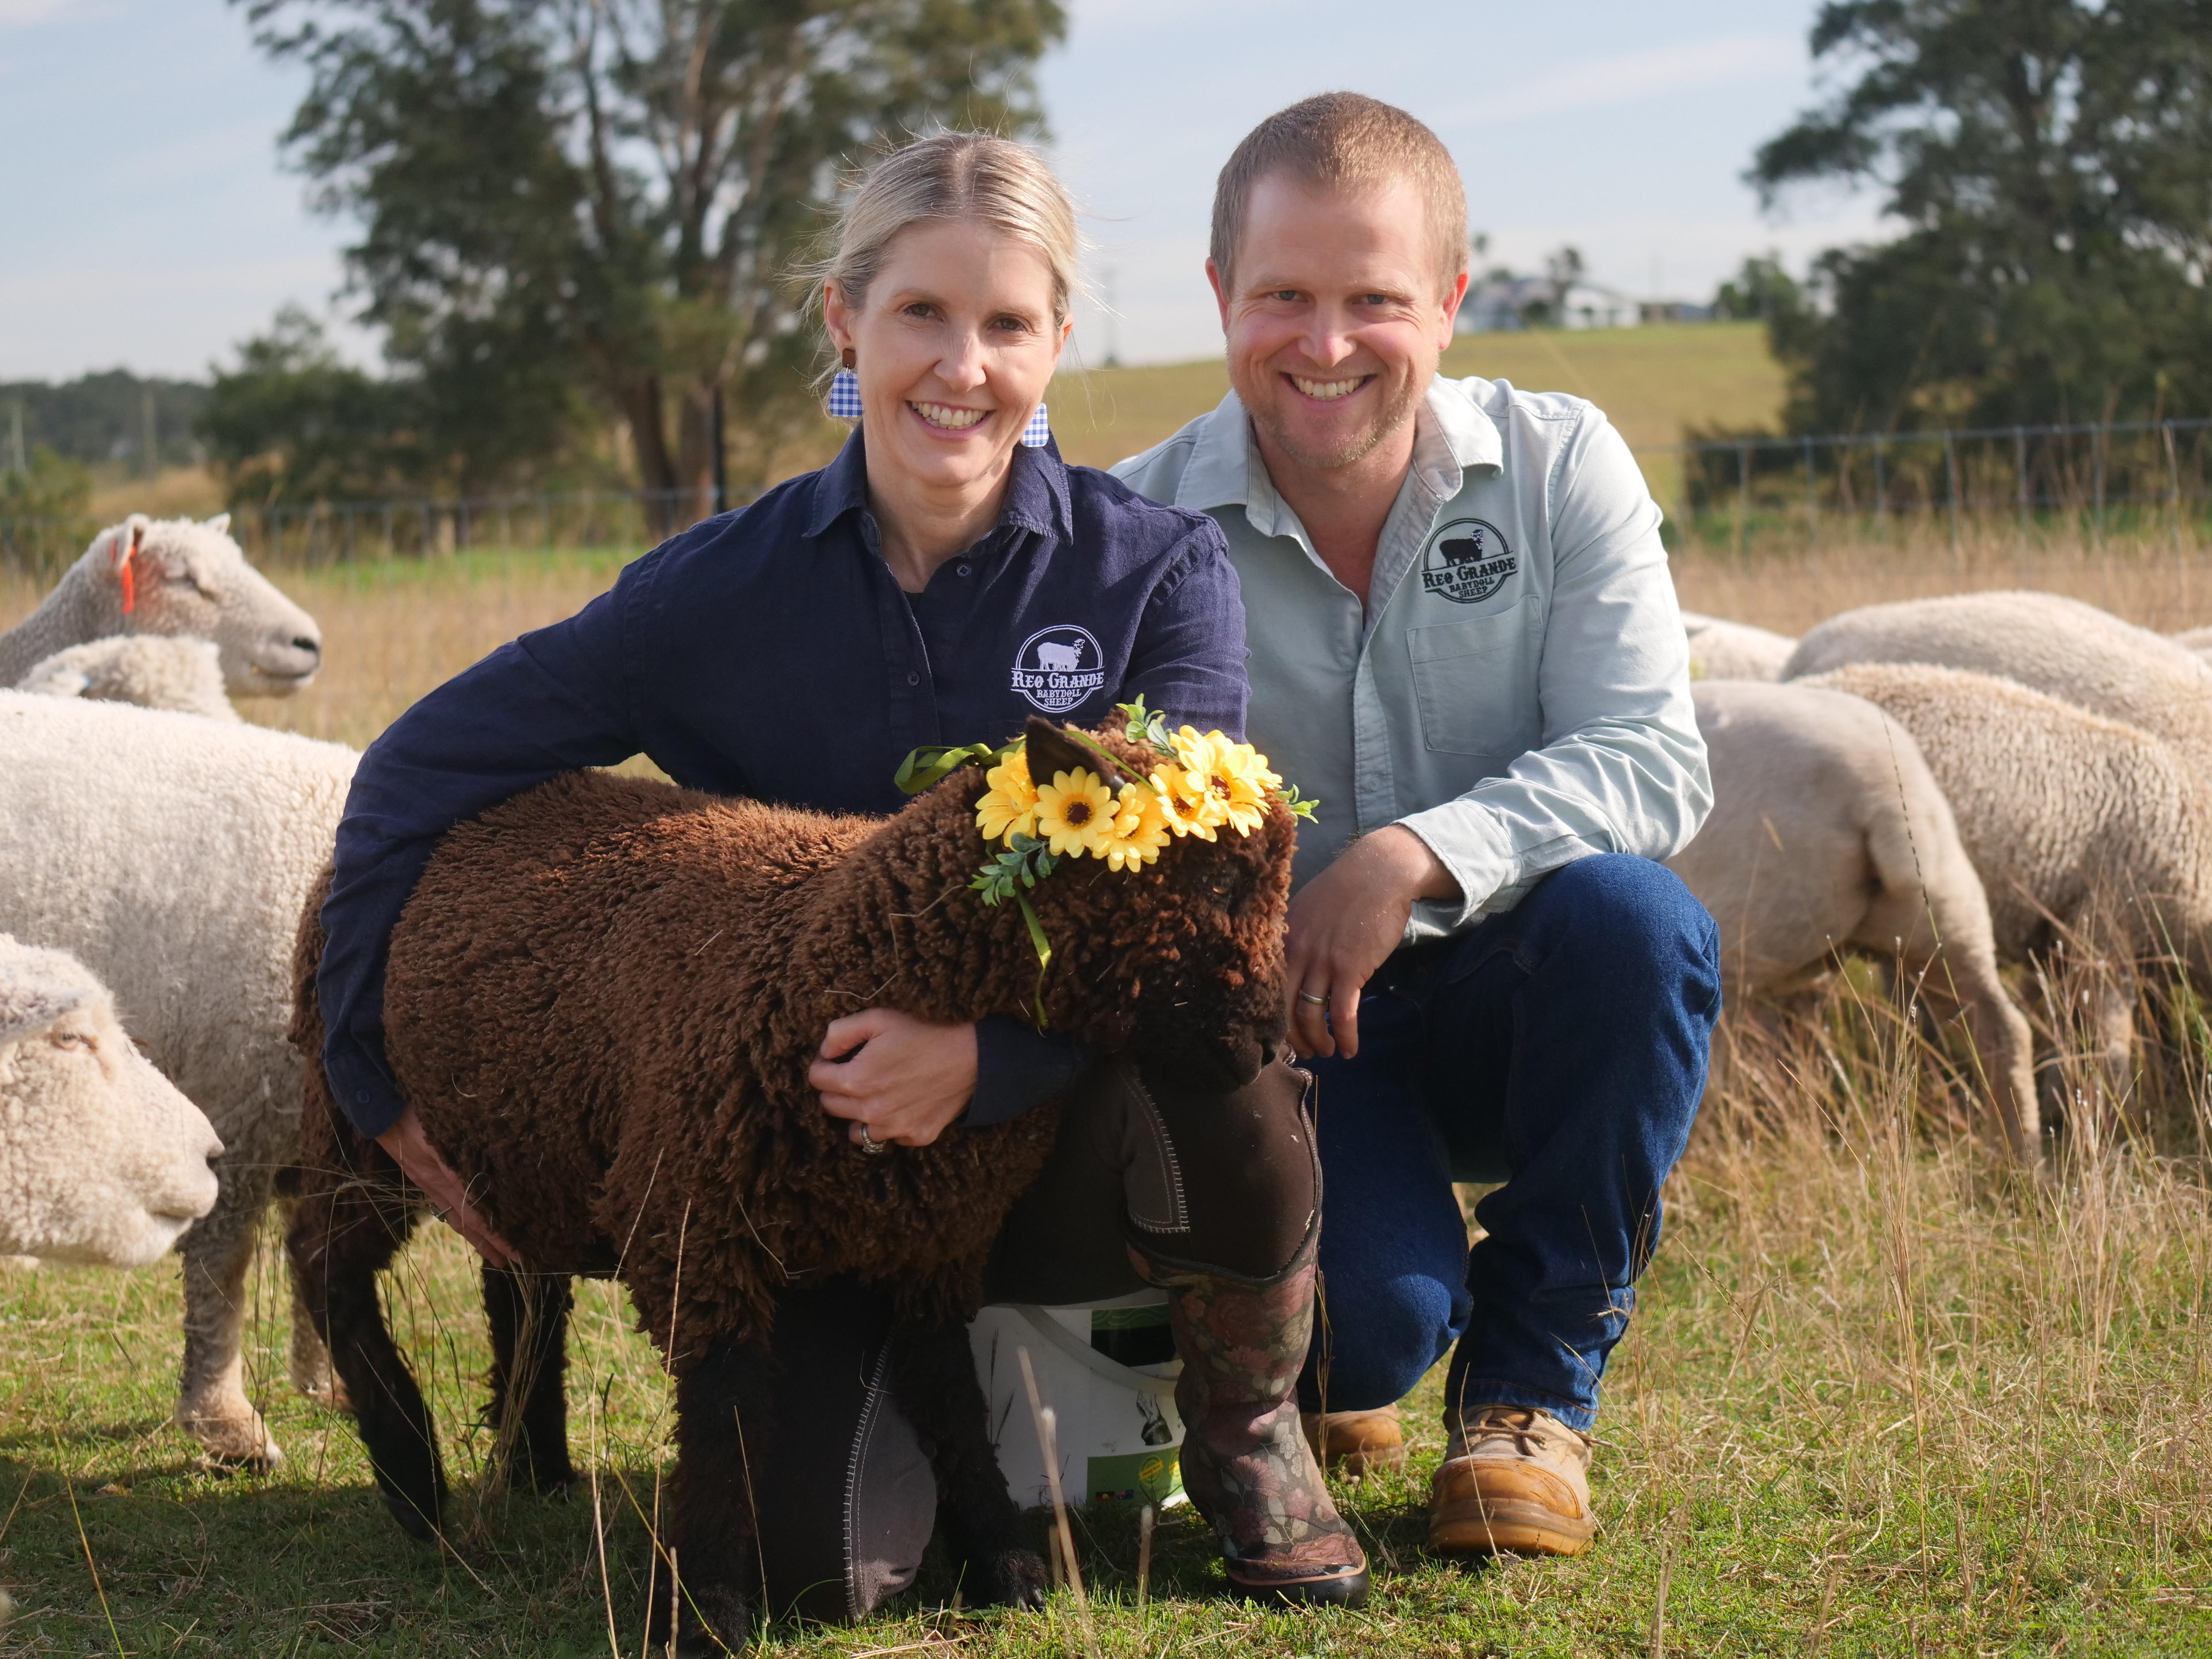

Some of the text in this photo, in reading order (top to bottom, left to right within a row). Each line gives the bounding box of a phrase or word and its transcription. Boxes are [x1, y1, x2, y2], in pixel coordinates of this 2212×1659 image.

[1448, 577, 1495, 593] BABYDOLL
[1459, 586, 1488, 598] SHEEP
[1036, 688, 1082, 698] BABYDOLL
[1044, 697, 1073, 707] SHEEP
